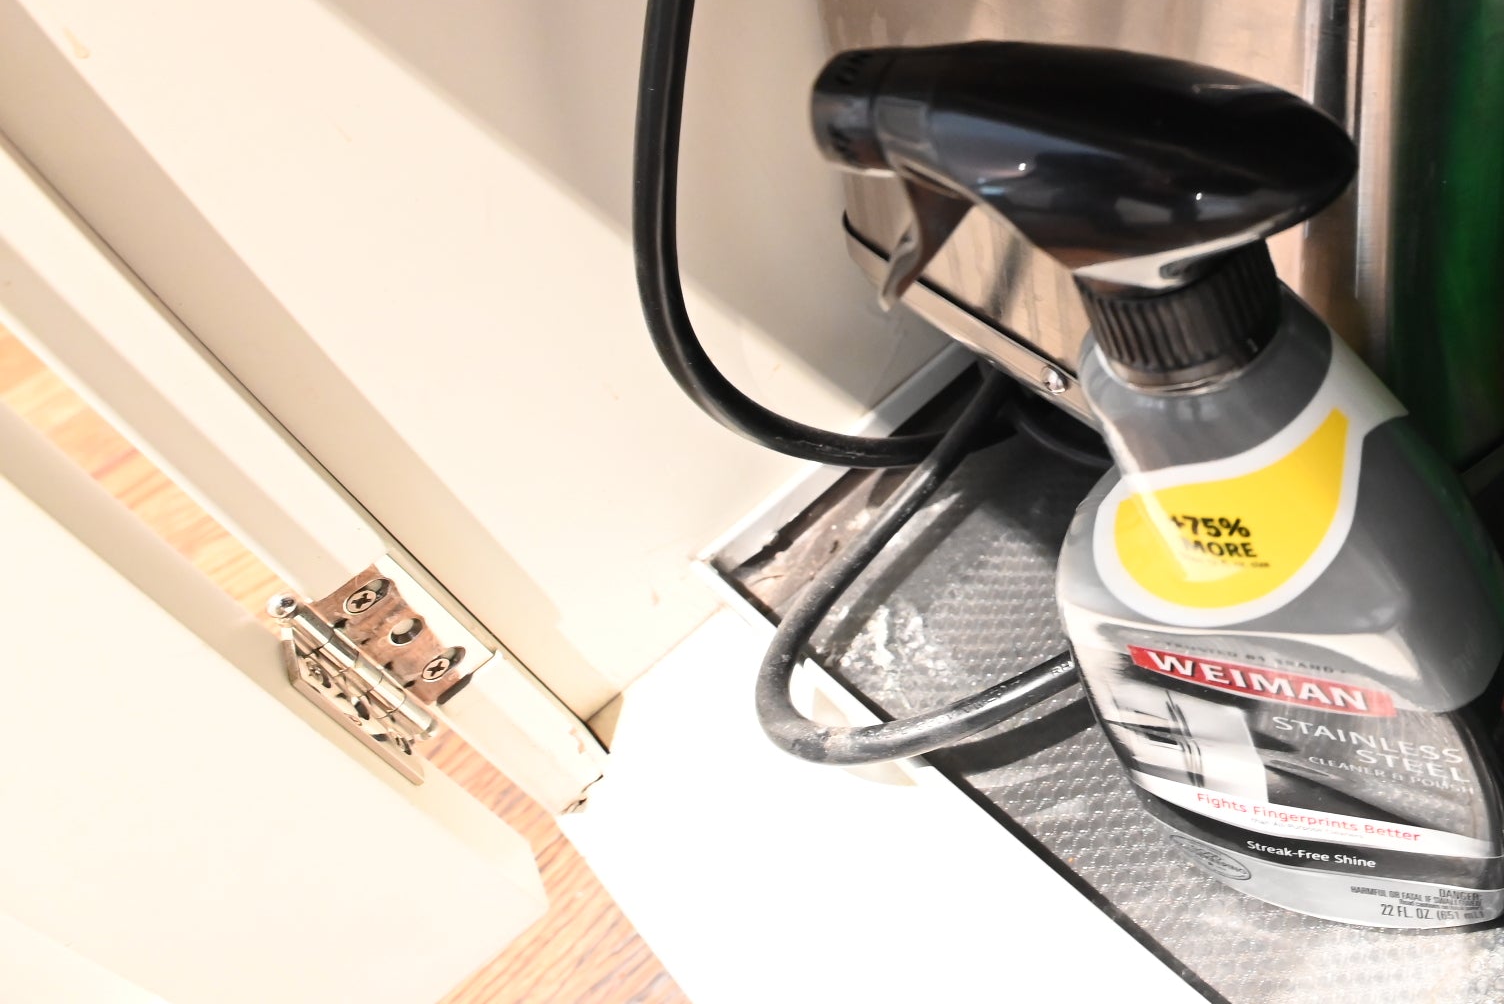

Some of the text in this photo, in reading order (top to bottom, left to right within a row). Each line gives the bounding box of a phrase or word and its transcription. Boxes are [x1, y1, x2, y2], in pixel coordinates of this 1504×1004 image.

[1170, 514, 1251, 538] +75%
[1182, 538, 1257, 558] MORE
[1145, 649, 1369, 711] WEIMAN
[1271, 715, 1465, 765] STAINLESS
[1308, 755, 1386, 778] CLEANER
[1410, 776, 1475, 795] POLISH
[1355, 748, 1471, 784] STEEL
[1196, 792, 1422, 842] Fights Fingerprints Better
[1247, 840, 1330, 863] Streak-Free
[1334, 853, 1377, 869] Shine
[1350, 885, 1388, 898] HARMFUL
[1389, 890, 1401, 899] OR
[1401, 891, 1423, 902] FATAL
[1381, 903, 1394, 917] 22
[1436, 910, 1460, 921] (651
